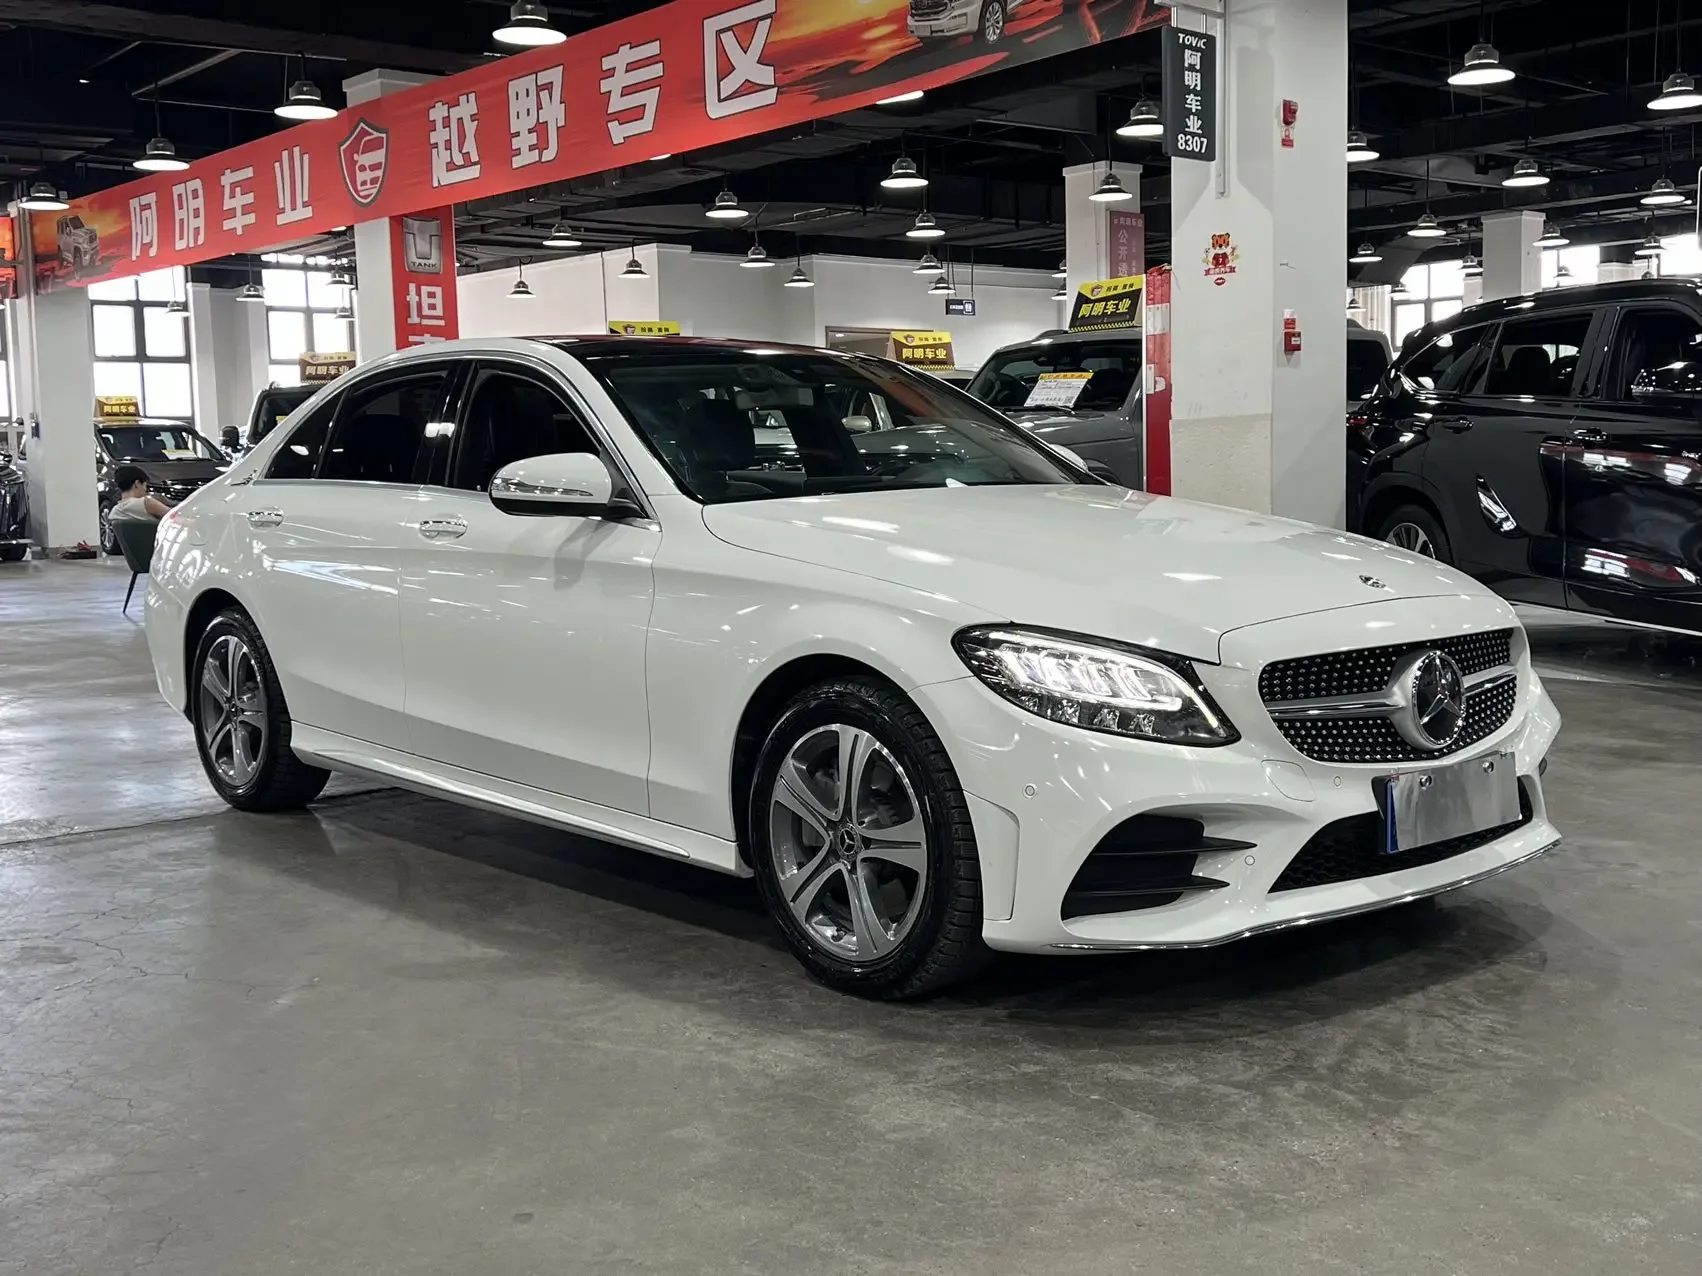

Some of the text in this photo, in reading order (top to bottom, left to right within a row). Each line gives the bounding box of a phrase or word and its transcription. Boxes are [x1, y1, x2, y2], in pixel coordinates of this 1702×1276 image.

[1178, 33, 1207, 49] TOVIC
[1184, 49, 1202, 133] 阿明车业
[129, 0, 778, 261] 阿明车业 越野专区
[1177, 134, 1207, 153] 8307
[406, 282, 446, 345] 坦
[1078, 298, 1131, 318] 阿明车业
[902, 348, 947, 359] 阿明车业
